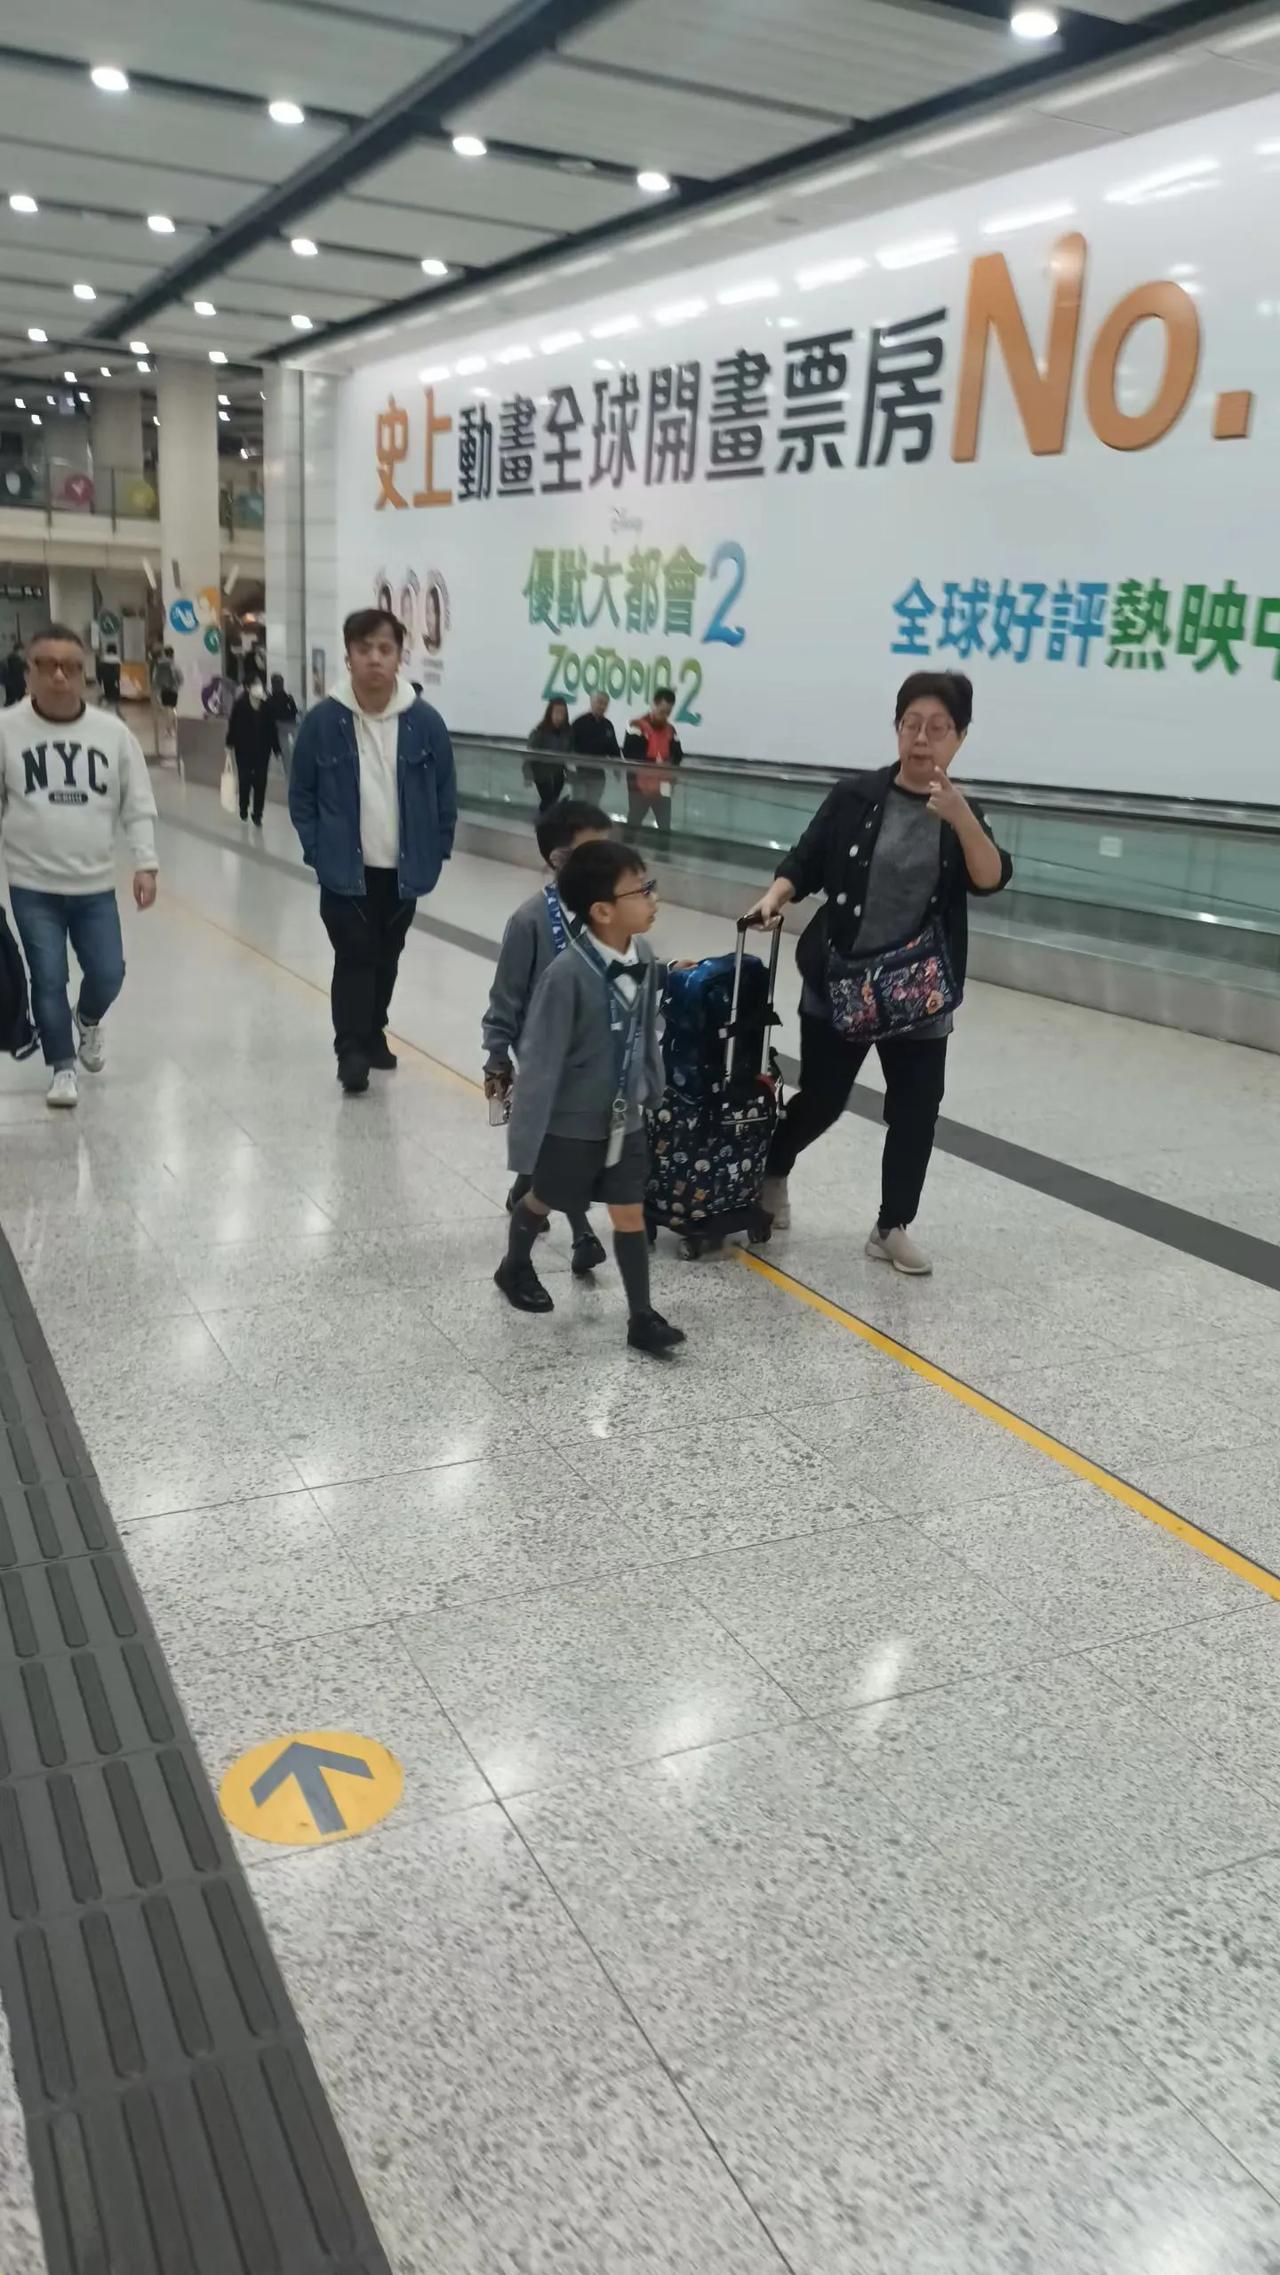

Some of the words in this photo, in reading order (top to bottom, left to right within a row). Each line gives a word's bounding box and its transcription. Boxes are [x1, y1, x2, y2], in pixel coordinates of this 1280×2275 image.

[374, 307, 948, 511] 史上動畫全球開畫票房
[22, 741, 109, 796] NYC
